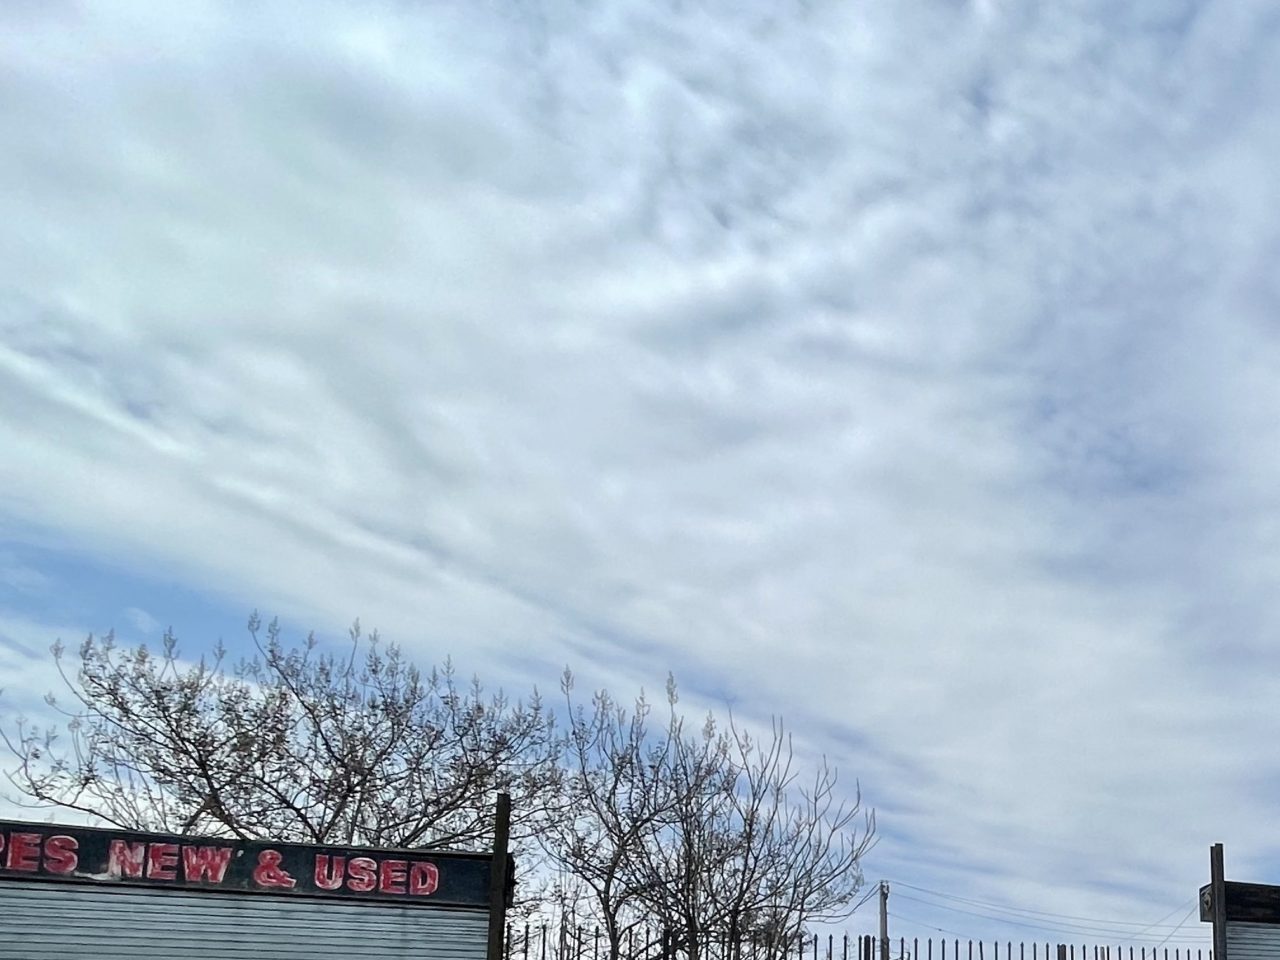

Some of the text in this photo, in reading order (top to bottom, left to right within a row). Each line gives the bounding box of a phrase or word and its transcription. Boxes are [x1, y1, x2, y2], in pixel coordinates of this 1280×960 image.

[0, 833, 439, 896] ES NEW & USED
